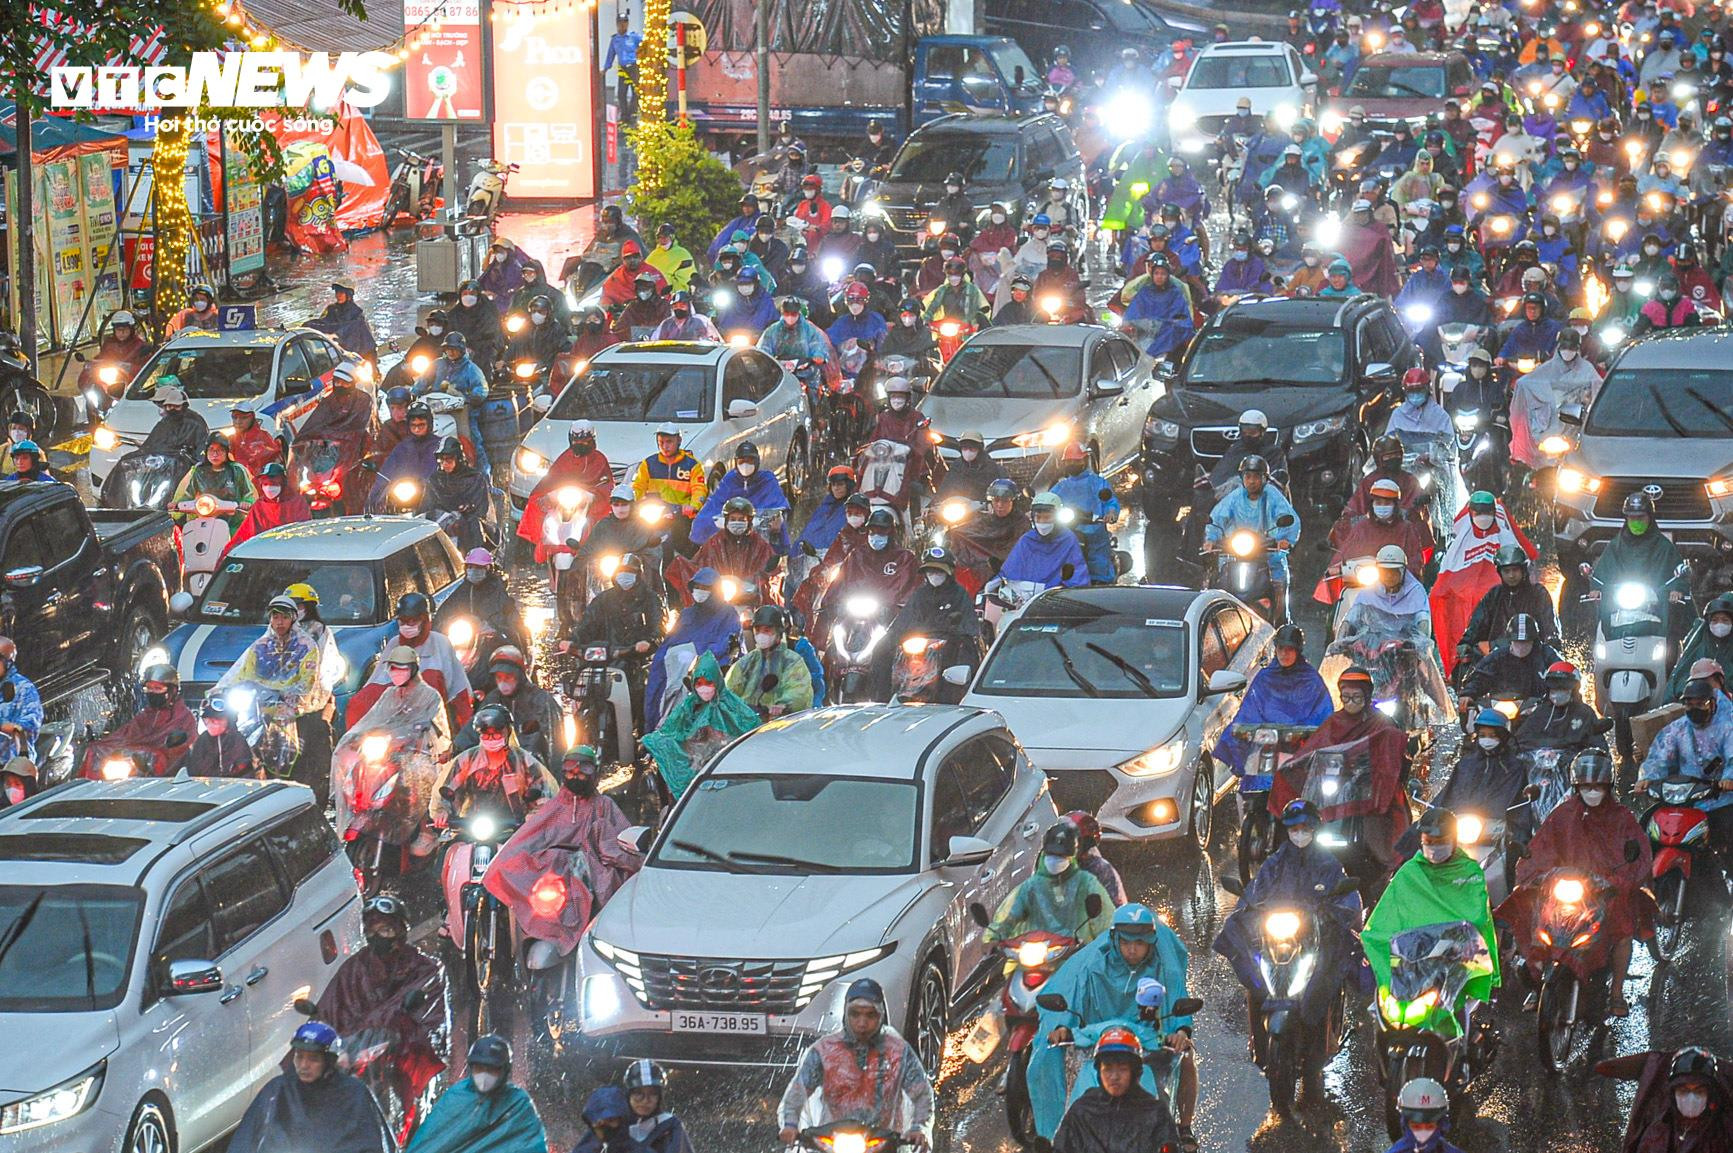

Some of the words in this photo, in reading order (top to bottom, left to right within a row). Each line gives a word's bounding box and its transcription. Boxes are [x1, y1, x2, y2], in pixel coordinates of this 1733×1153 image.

[449, 6, 462, 16] 87
[465, 6, 478, 16] 86
[676, 465, 690, 480] be
[679, 1015, 759, 1031] 36A-738.95
